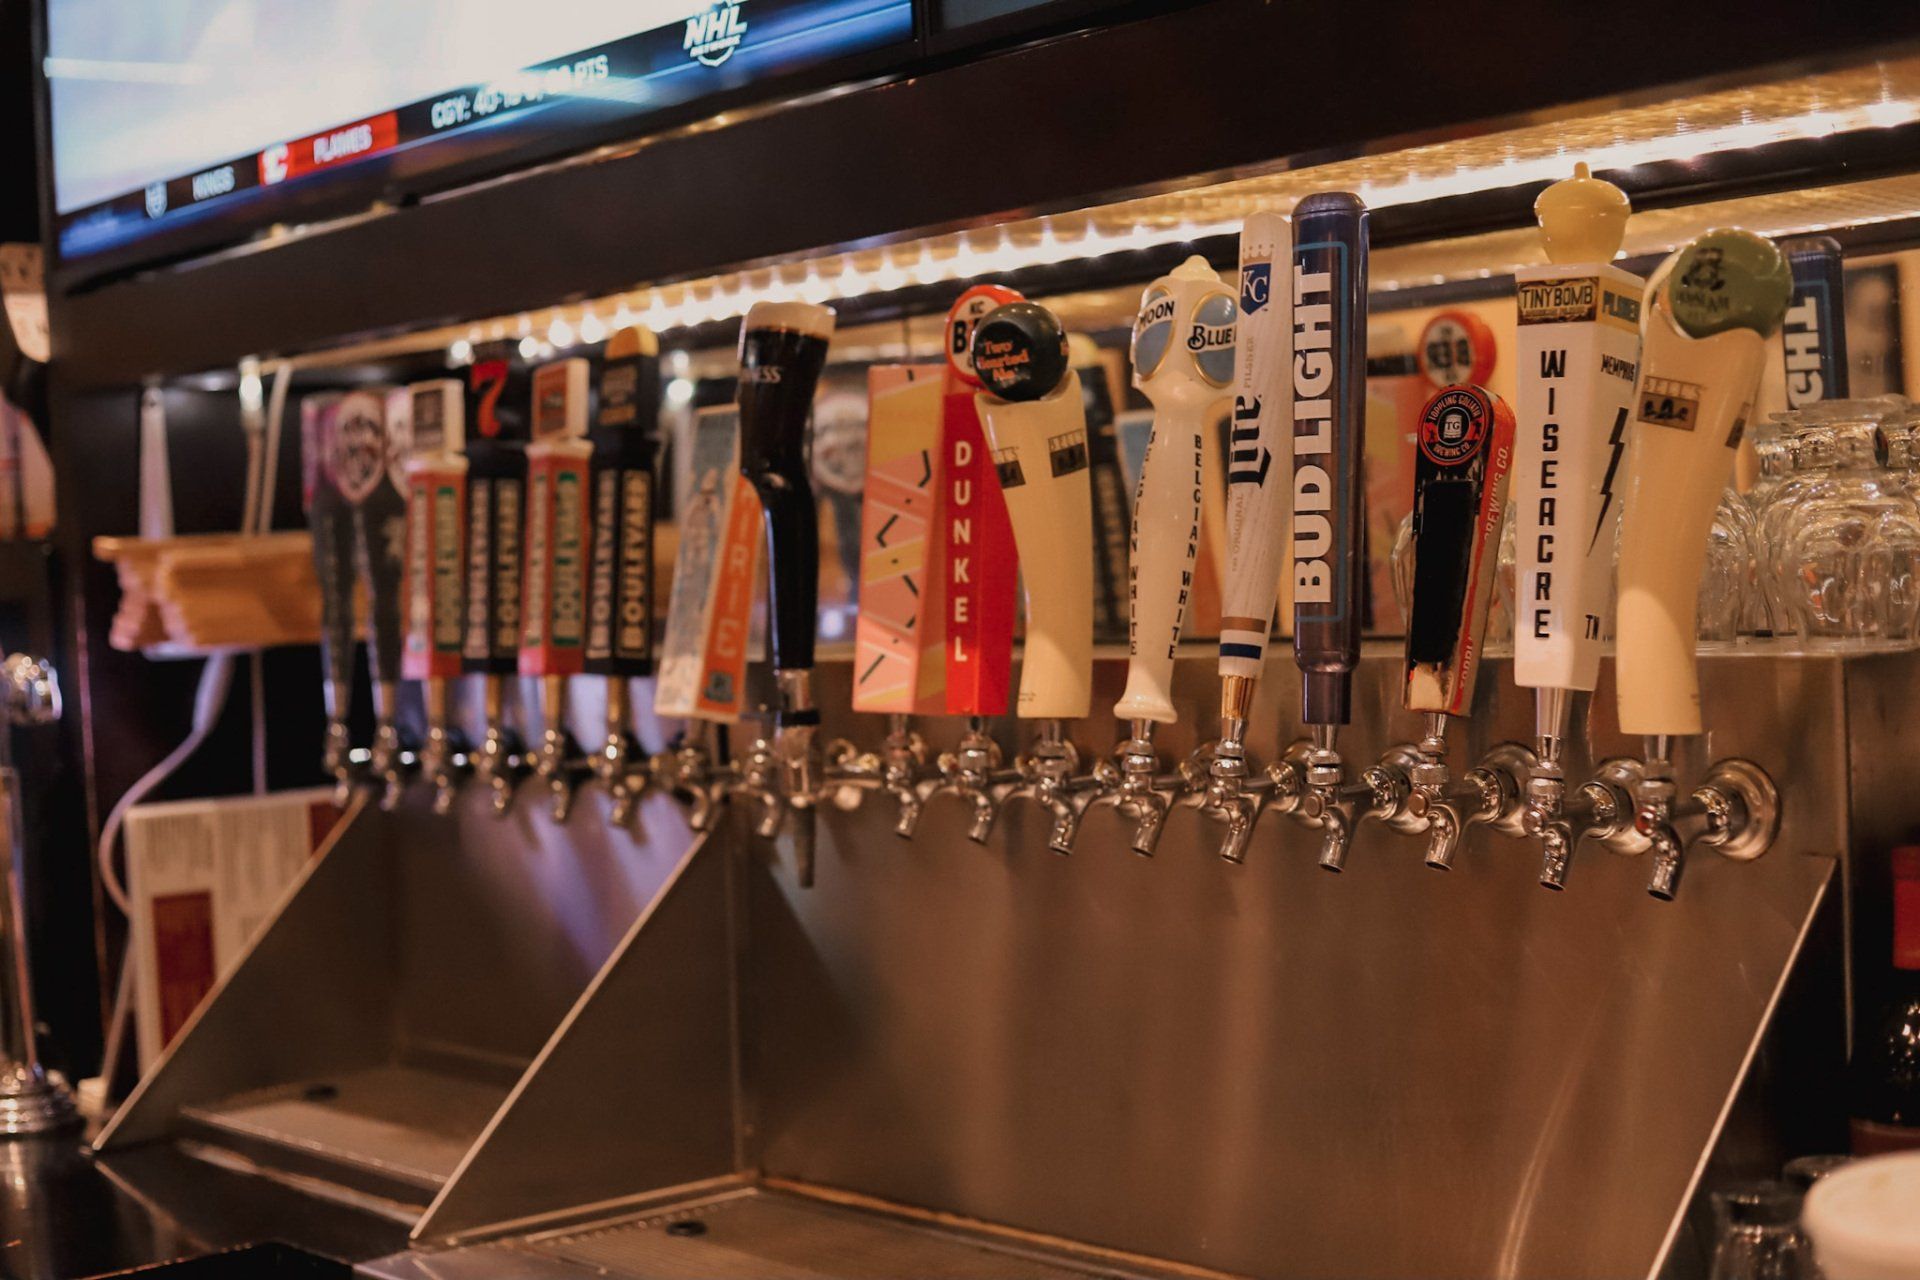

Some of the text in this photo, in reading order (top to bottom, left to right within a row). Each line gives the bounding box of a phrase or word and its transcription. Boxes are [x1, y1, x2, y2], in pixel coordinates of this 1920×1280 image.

[683, 5, 748, 50] NHL
[313, 124, 373, 165] FLAMES
[1242, 269, 1268, 303] KC
[1521, 286, 1593, 309] TINY BOMB
[1140, 301, 1175, 326] MOON
[1187, 325, 1232, 350] BLUE
[1428, 394, 1457, 420] TOPPLING
[1230, 394, 1272, 488] Lite
[1294, 265, 1333, 603] BUD LIGHT
[1446, 421, 1460, 431] TG
[1496, 446, 1509, 474] CO.
[1533, 350, 1566, 639] WISEACRE
[953, 441, 973, 662] DUNKEL
[1168, 434, 1202, 660] BELGIAN WHITE
